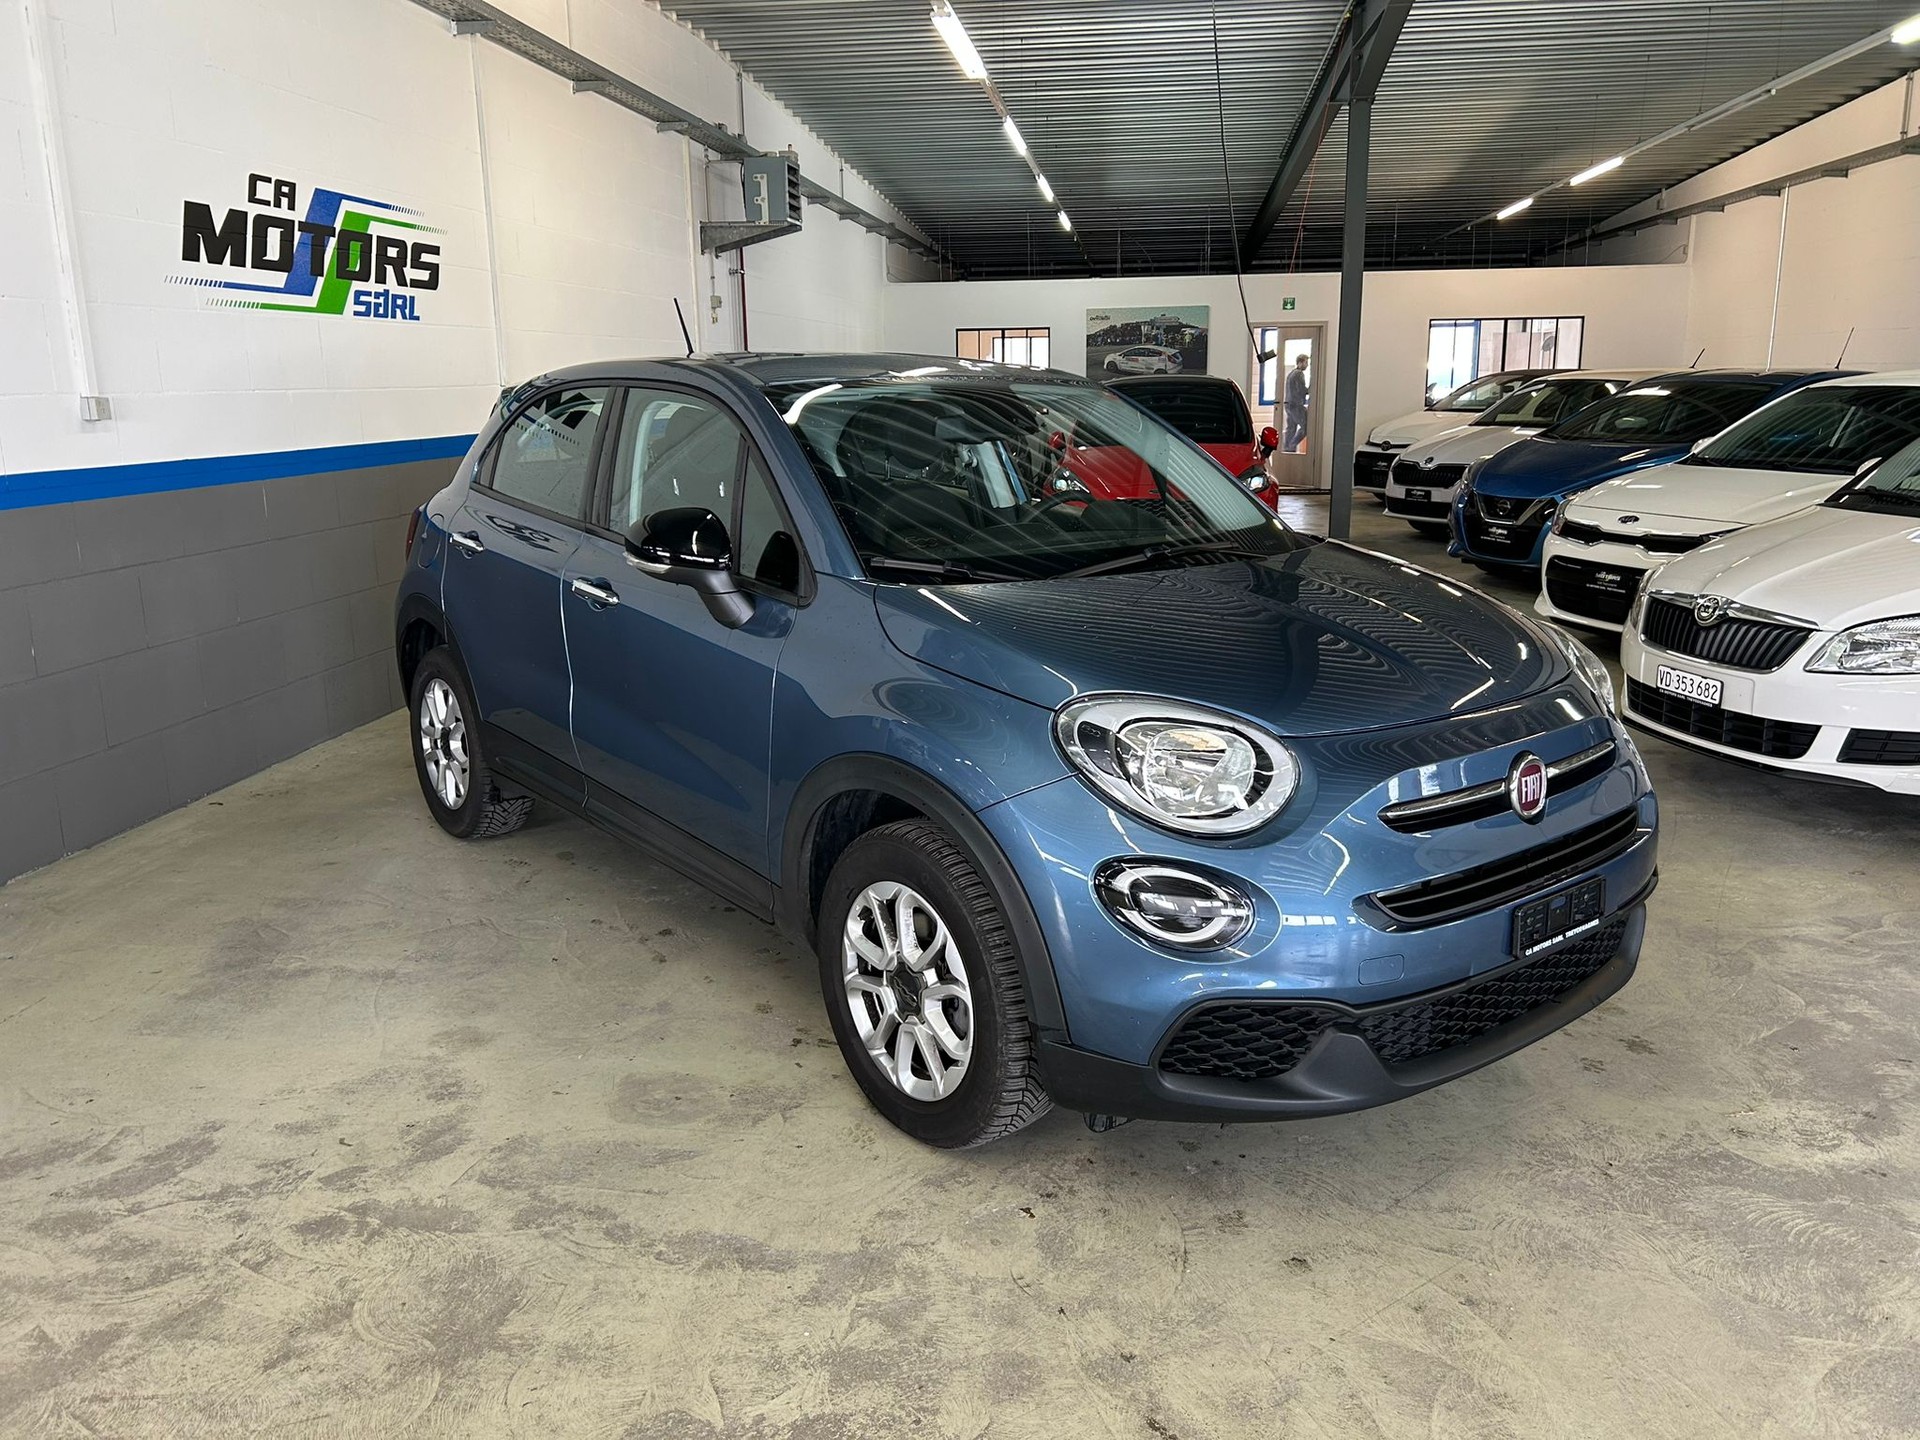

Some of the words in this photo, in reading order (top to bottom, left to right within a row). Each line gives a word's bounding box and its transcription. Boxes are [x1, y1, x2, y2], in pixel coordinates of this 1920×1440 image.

[247, 172, 297, 212] CA
[181, 200, 441, 291] MOTORS
[1696, 680, 1719, 702] 682
[1521, 772, 1541, 804] FIAT
